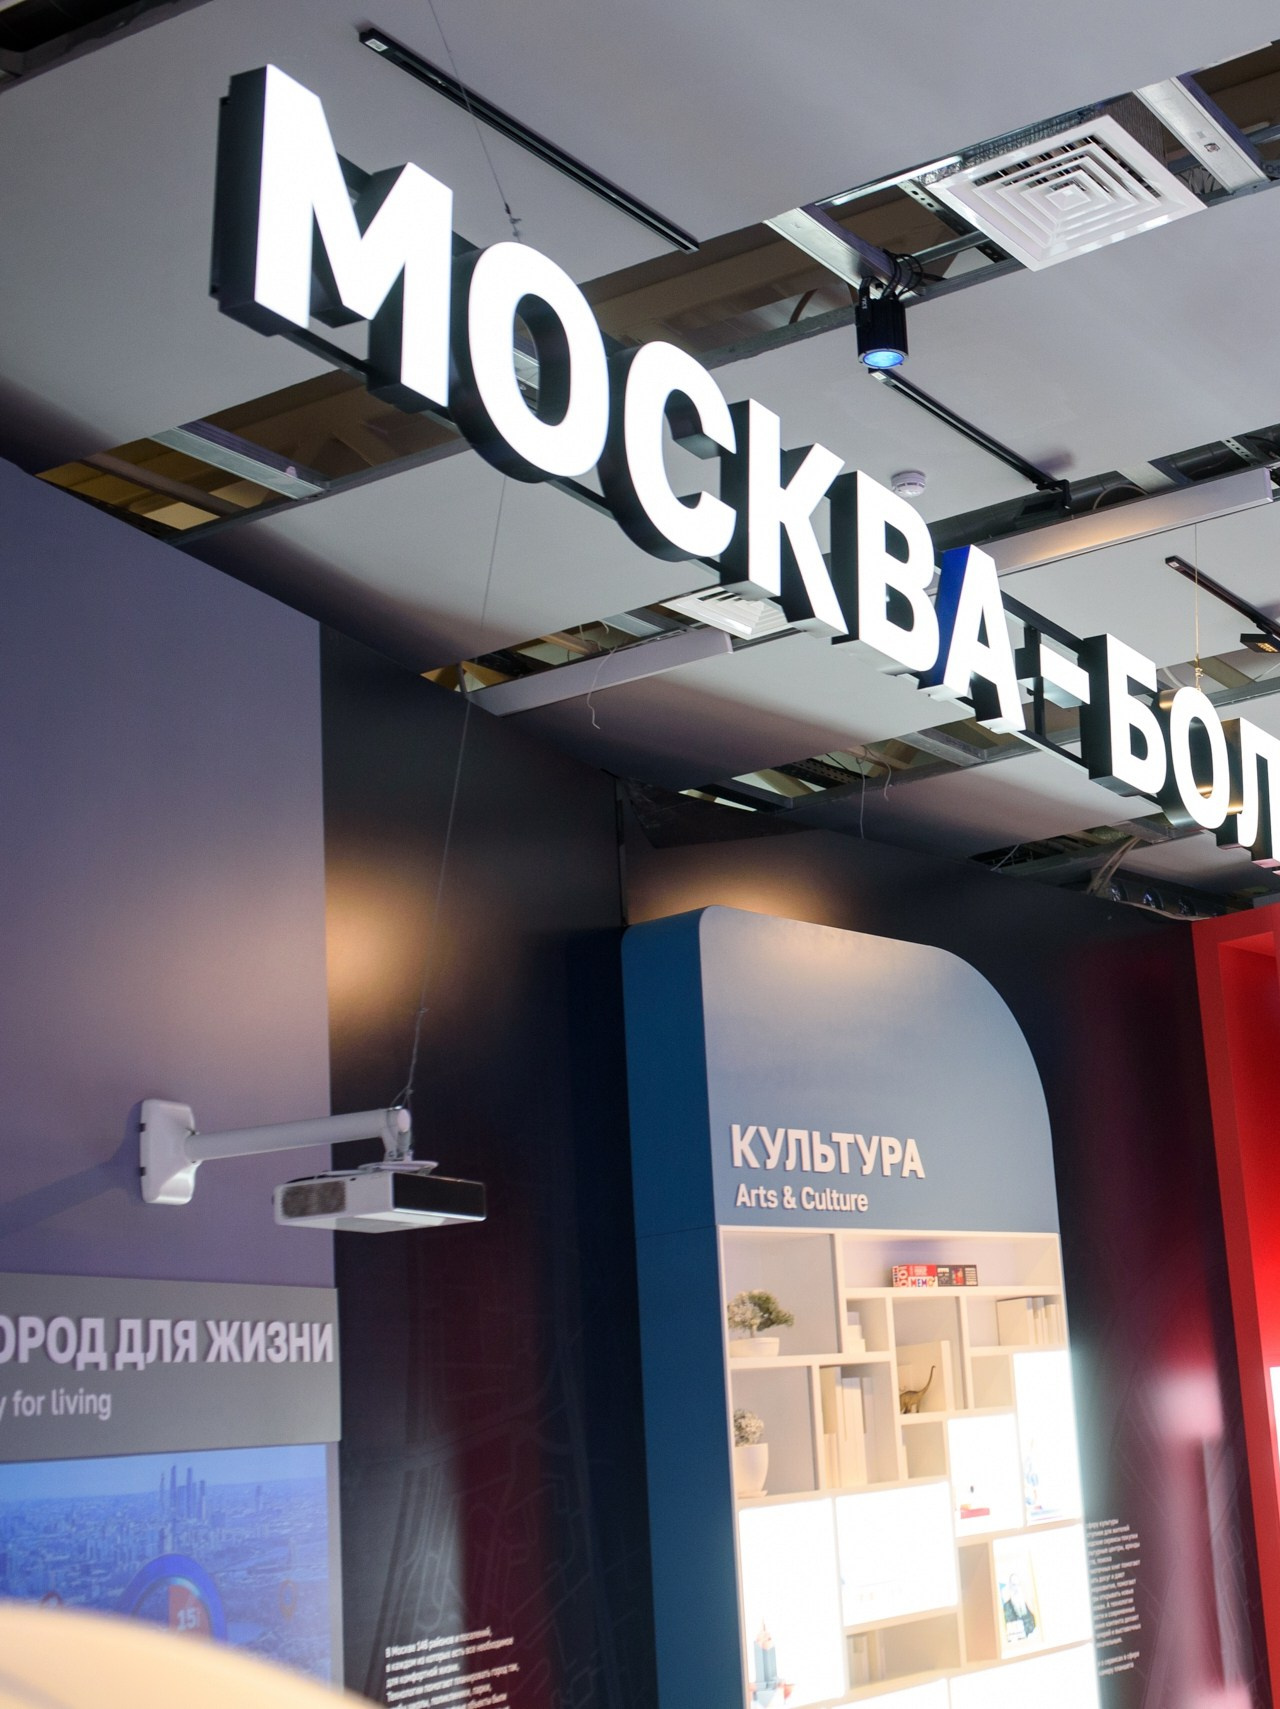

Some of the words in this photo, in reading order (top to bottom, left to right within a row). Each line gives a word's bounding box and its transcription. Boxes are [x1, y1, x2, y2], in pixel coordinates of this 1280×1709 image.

[253, 64, 1026, 732] МОСКВА
[731, 1124, 926, 1179] КУЛЬТУРА
[736, 1183, 778, 1209] Arts
[783, 1185, 797, 1210] &
[801, 1187, 869, 1212] Culture
[115, 1319, 198, 1371] ДЛЯ
[205, 1320, 335, 1364] ЖИЗНИ
[13, 1390, 45, 1418] for
[51, 1387, 112, 1421] living
